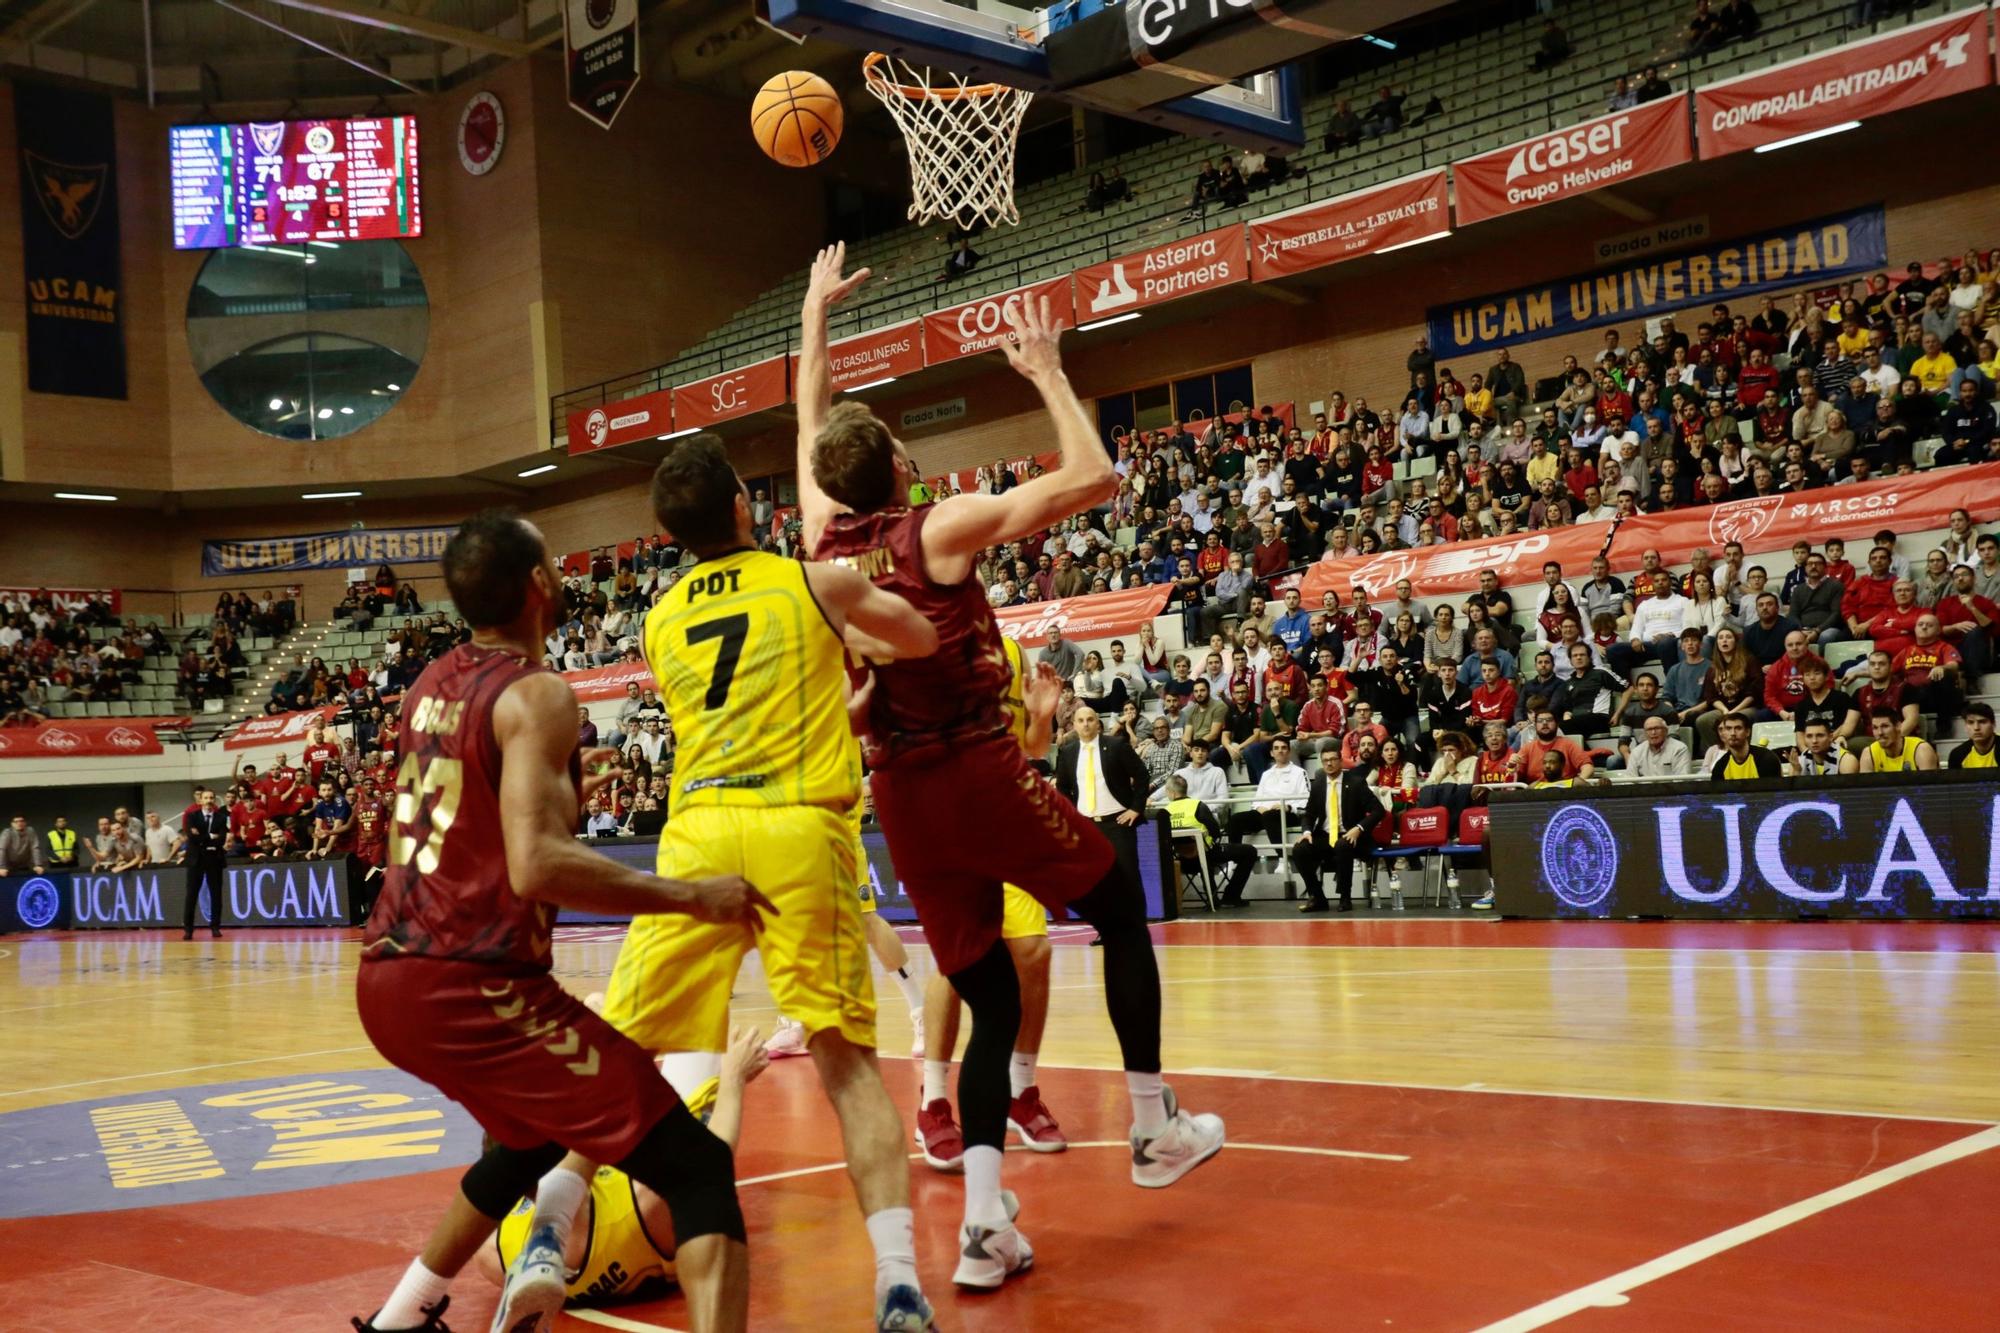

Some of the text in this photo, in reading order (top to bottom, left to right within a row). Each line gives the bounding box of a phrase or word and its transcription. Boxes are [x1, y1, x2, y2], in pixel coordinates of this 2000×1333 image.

[586, 59, 606, 76] LIGA
[1712, 55, 1928, 132] COMPRALAENTRADA
[1528, 116, 1630, 172] caser
[254, 164, 282, 183] 71
[306, 161, 336, 181] 67
[1507, 158, 1634, 205] Grupo Helvetia
[253, 207, 266, 221] 2
[1281, 222, 1355, 251] ESTRELLA
[1367, 197, 1438, 229] LEVANTE
[1143, 238, 1216, 274] Asterra
[1600, 221, 1704, 258] Grada Norte
[30, 278, 116, 309] UCAM
[1143, 261, 1230, 299] Partners
[1452, 223, 1849, 347] UCAM UNIVERSIDAD
[31, 302, 115, 323] UNIVERSIDAD
[842, 339, 910, 369] GASOLINERAS
[1718, 499, 1779, 513] PEUGEOT
[1790, 492, 1899, 519] MARCOS
[220, 540, 295, 569] UCAM
[1462, 534, 1550, 567] ESP
[687, 568, 742, 604] POT
[1634, 585, 1654, 596] UCA
[685, 612, 750, 711] 7
[389, 752, 463, 874] 23
[73, 874, 165, 922] UCAM
[228, 865, 342, 921] UCAM
[199, 1080, 447, 1171] UCAM
[88, 1100, 227, 1189] UNIVERSIDAD
